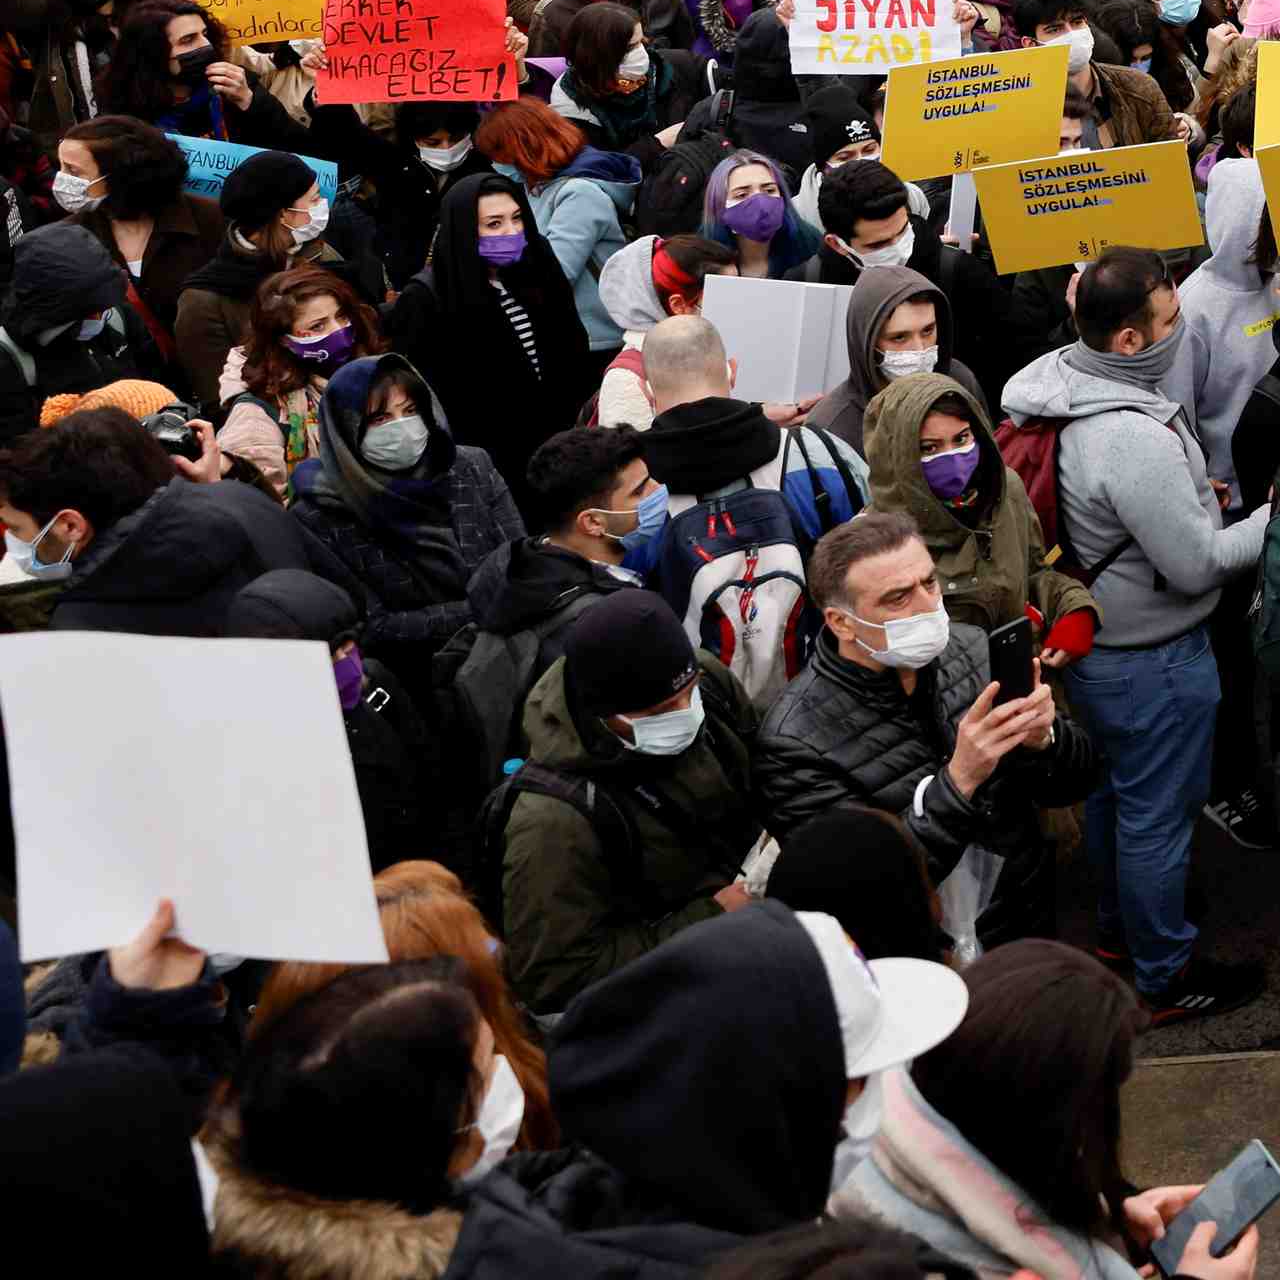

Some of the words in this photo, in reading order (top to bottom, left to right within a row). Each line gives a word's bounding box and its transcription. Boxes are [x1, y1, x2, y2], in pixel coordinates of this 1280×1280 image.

[322, 15, 442, 47] DEVLET
[387, 62, 507, 100] ELBET!
[927, 62, 999, 85] İSTANBUL
[925, 75, 1031, 103] SÖZLEŞMESİNİ
[923, 101, 986, 120] UYGULA!
[1018, 161, 1106, 184] İSTANBUL
[1022, 169, 1147, 200] SÖZLEŞMESİNİ
[1026, 197, 1101, 216] UYGULA!
